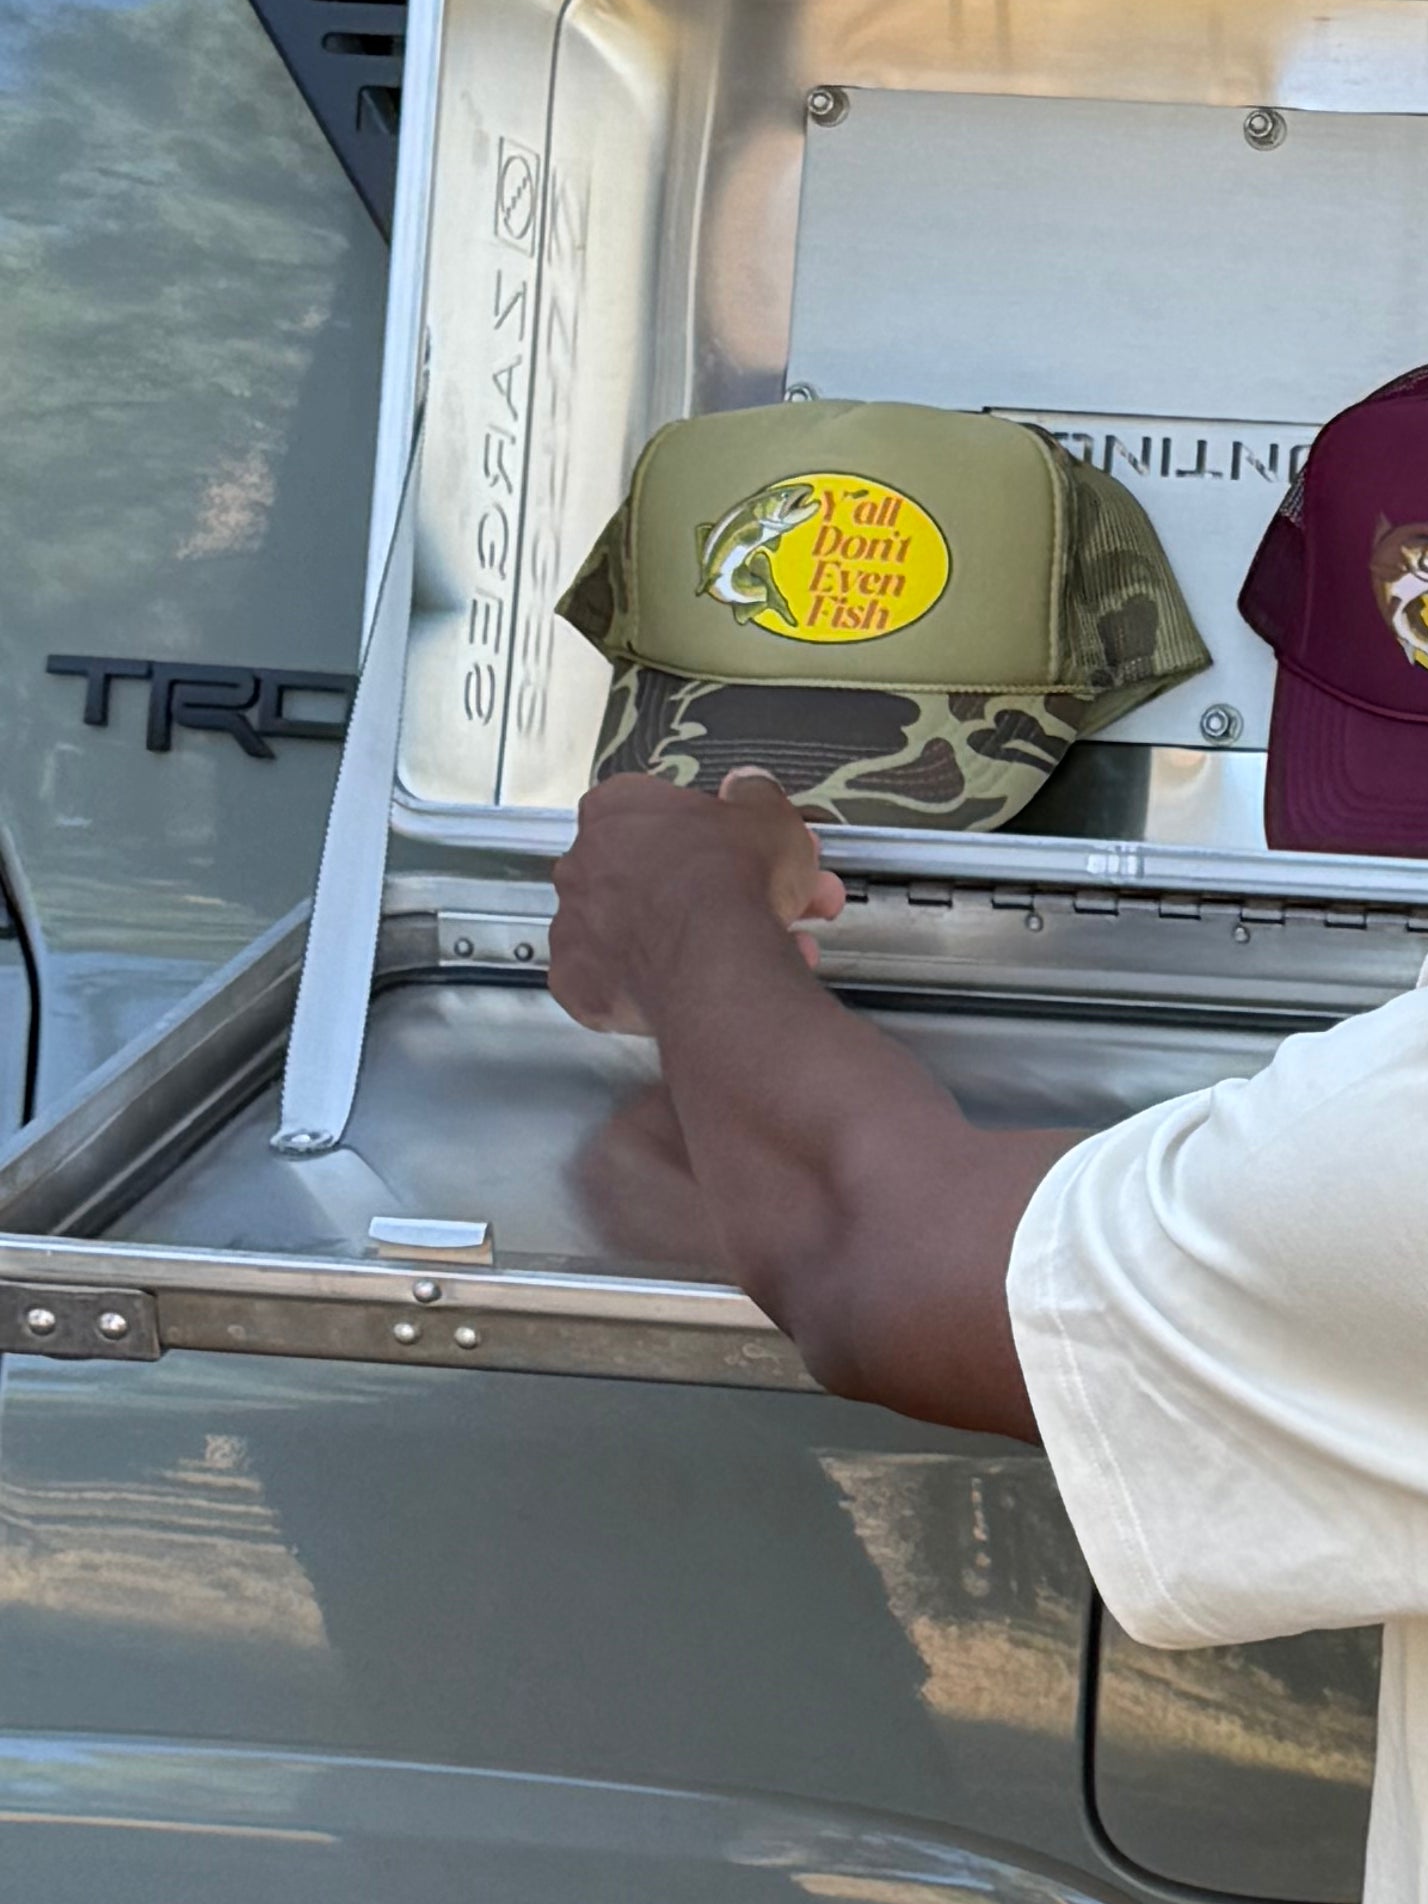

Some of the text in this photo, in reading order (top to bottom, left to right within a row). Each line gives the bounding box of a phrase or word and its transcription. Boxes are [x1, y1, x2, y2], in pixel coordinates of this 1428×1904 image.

[812, 526, 912, 564] Don't
[809, 560, 906, 597] Even
[806, 595, 890, 630] Fish
